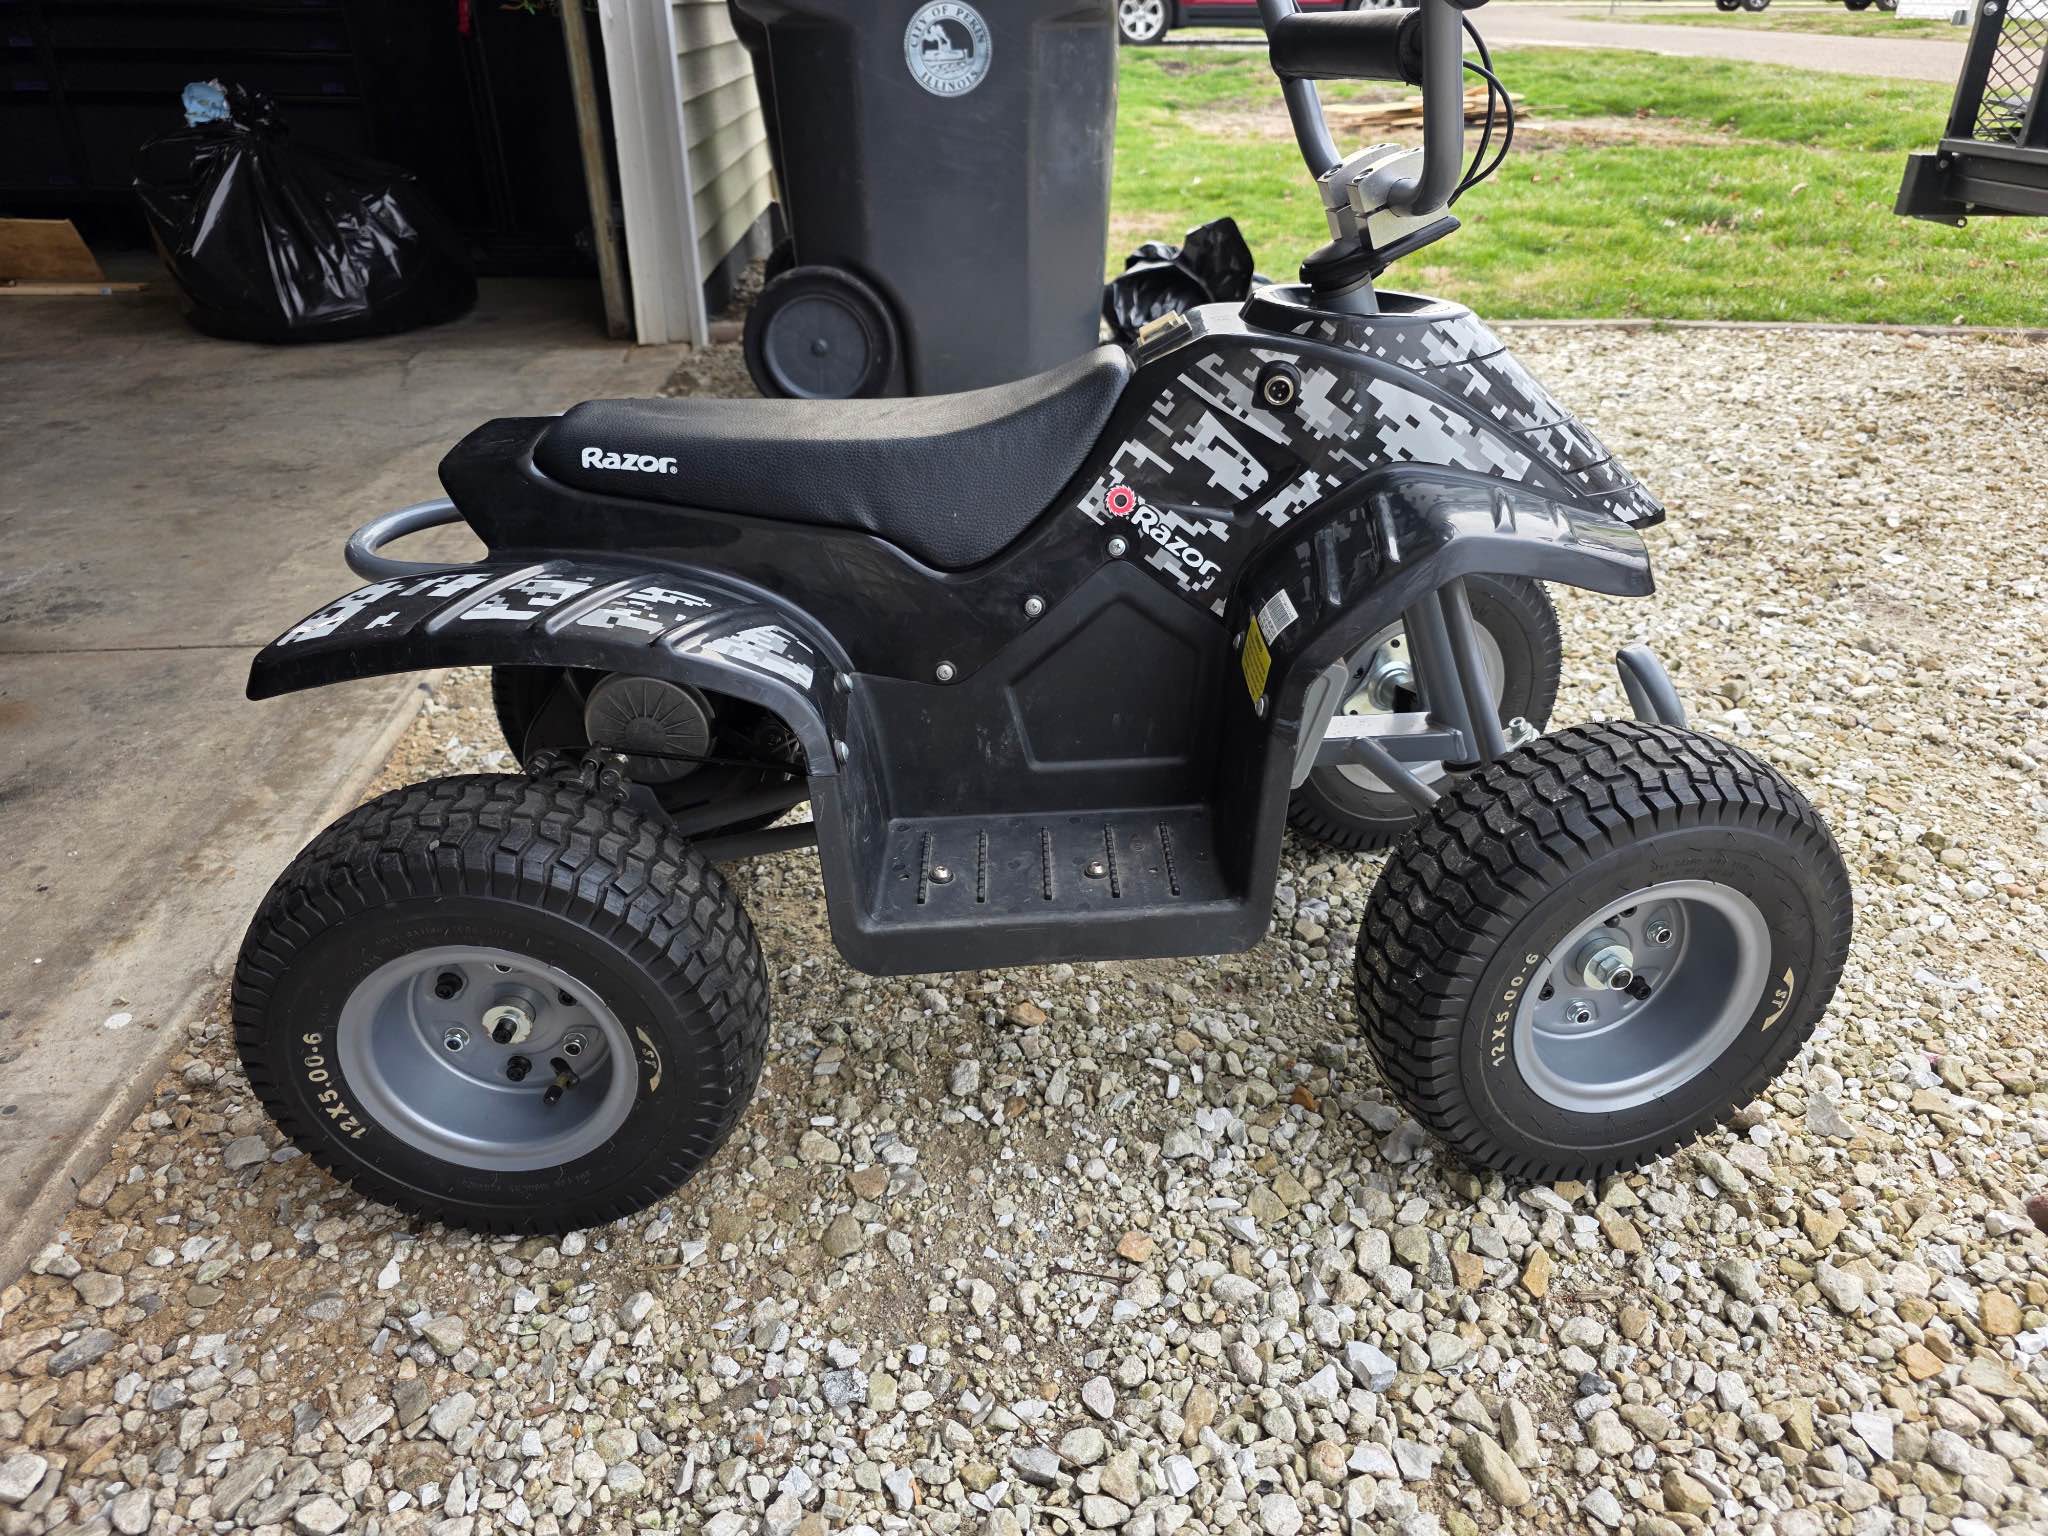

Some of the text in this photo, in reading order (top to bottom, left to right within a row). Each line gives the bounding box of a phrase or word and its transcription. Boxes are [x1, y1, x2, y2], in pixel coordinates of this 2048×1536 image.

[911, 5, 985, 48] CITY OF PEKIN
[922, 71, 981, 91] ILLINOIS
[581, 447, 678, 474] Razor
[1131, 505, 1222, 576] Razor
